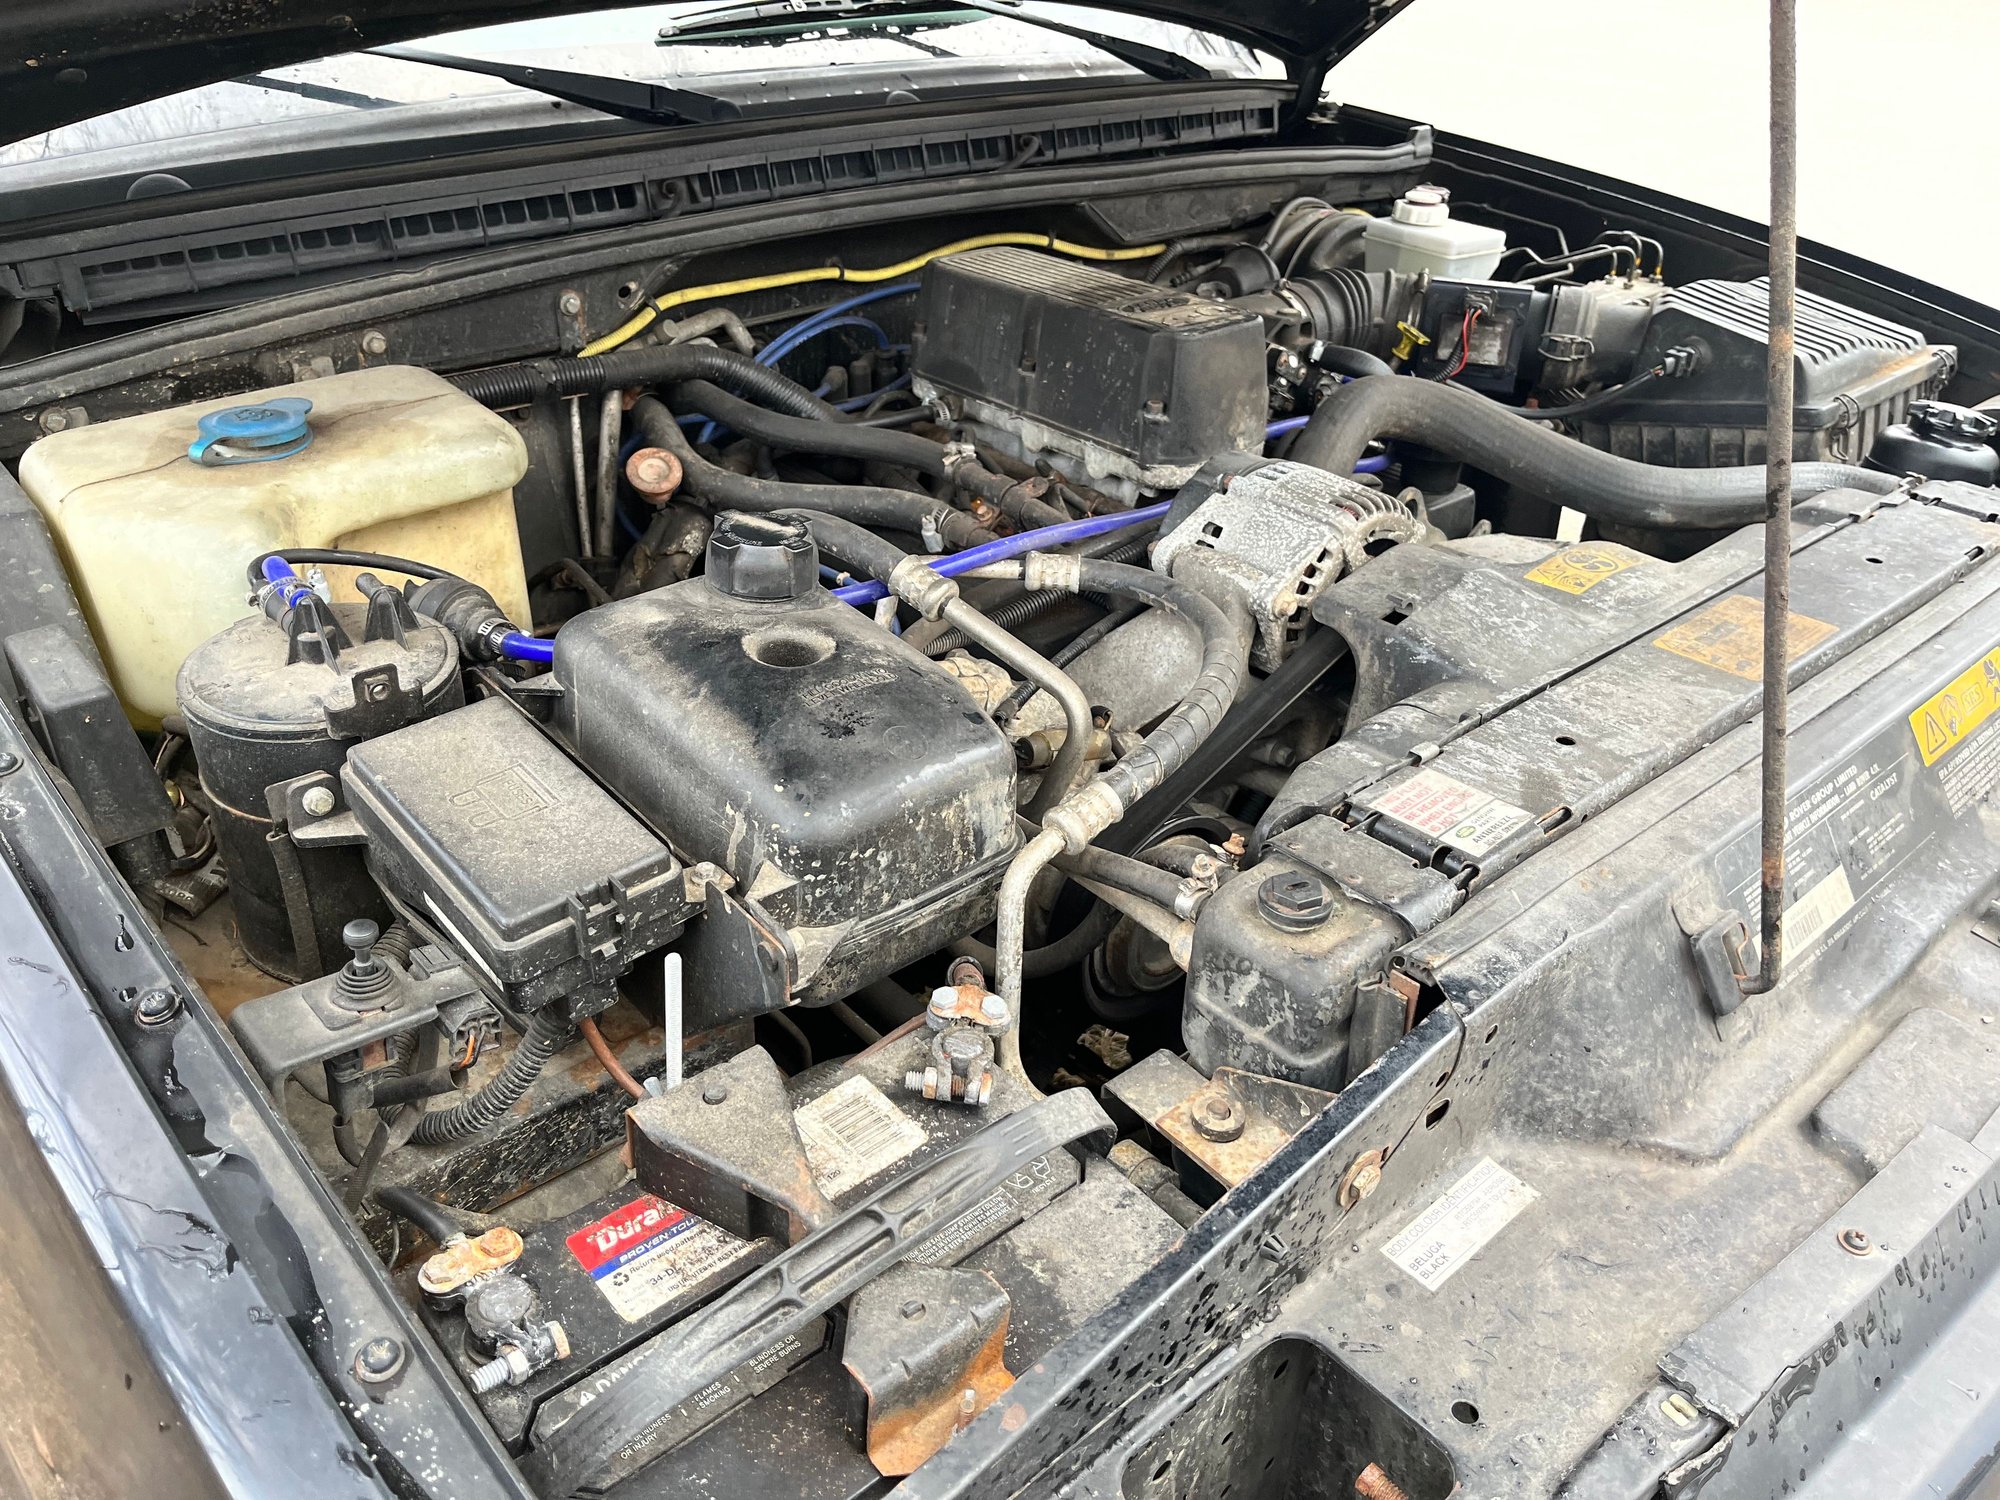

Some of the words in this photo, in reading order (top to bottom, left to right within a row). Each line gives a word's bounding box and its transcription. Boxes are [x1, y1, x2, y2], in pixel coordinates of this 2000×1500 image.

[502, 780, 533, 804] FUSES
[1389, 797, 1415, 813] MUST
[1412, 784, 1433, 800] NOT
[1788, 799, 1811, 821] ROVER
[1810, 782, 1834, 805] GROUP
[1833, 764, 1857, 788] LIMITED
[1869, 772, 1898, 800] CATALYST
[1403, 810, 1421, 821] BE
[1416, 786, 1459, 814] REMOVED
[1417, 809, 1445, 827] WHEN
[1472, 815, 1513, 844] ANTIFREEZE
[826, 1168, 842, 1181] 120
[919, 1241, 932, 1252] FOR
[930, 1232, 945, 1245] SAFE
[944, 1223, 958, 1236] JUMP
[958, 1208, 983, 1226] STARTING
[981, 1195, 1003, 1211] FOLLOW
[943, 1227, 966, 1244] VEHICLE
[985, 1201, 1007, 1218] MANUAL
[1386, 1234, 1411, 1257] BODY
[1408, 1208, 1443, 1237] COLOUR
[1440, 1161, 1496, 1214] IDENTIFICATION
[961, 1224, 983, 1241] SERVICE
[619, 1232, 669, 1263] PROVEN
[629, 1256, 656, 1274] Return
[656, 1245, 674, 1259] used
[1408, 1240, 1446, 1272] BELUGA
[1419, 1253, 1451, 1280] BLACK
[748, 1340, 786, 1368] BLINDNESS
[784, 1333, 797, 1346] OR
[753, 1353, 780, 1375] SEVERE
[777, 1340, 802, 1360] BURNS
[694, 1380, 722, 1404] FLAMES
[699, 1385, 732, 1409] SMOKING
[620, 1446, 633, 1460] OR
[631, 1431, 659, 1454] INJURY
